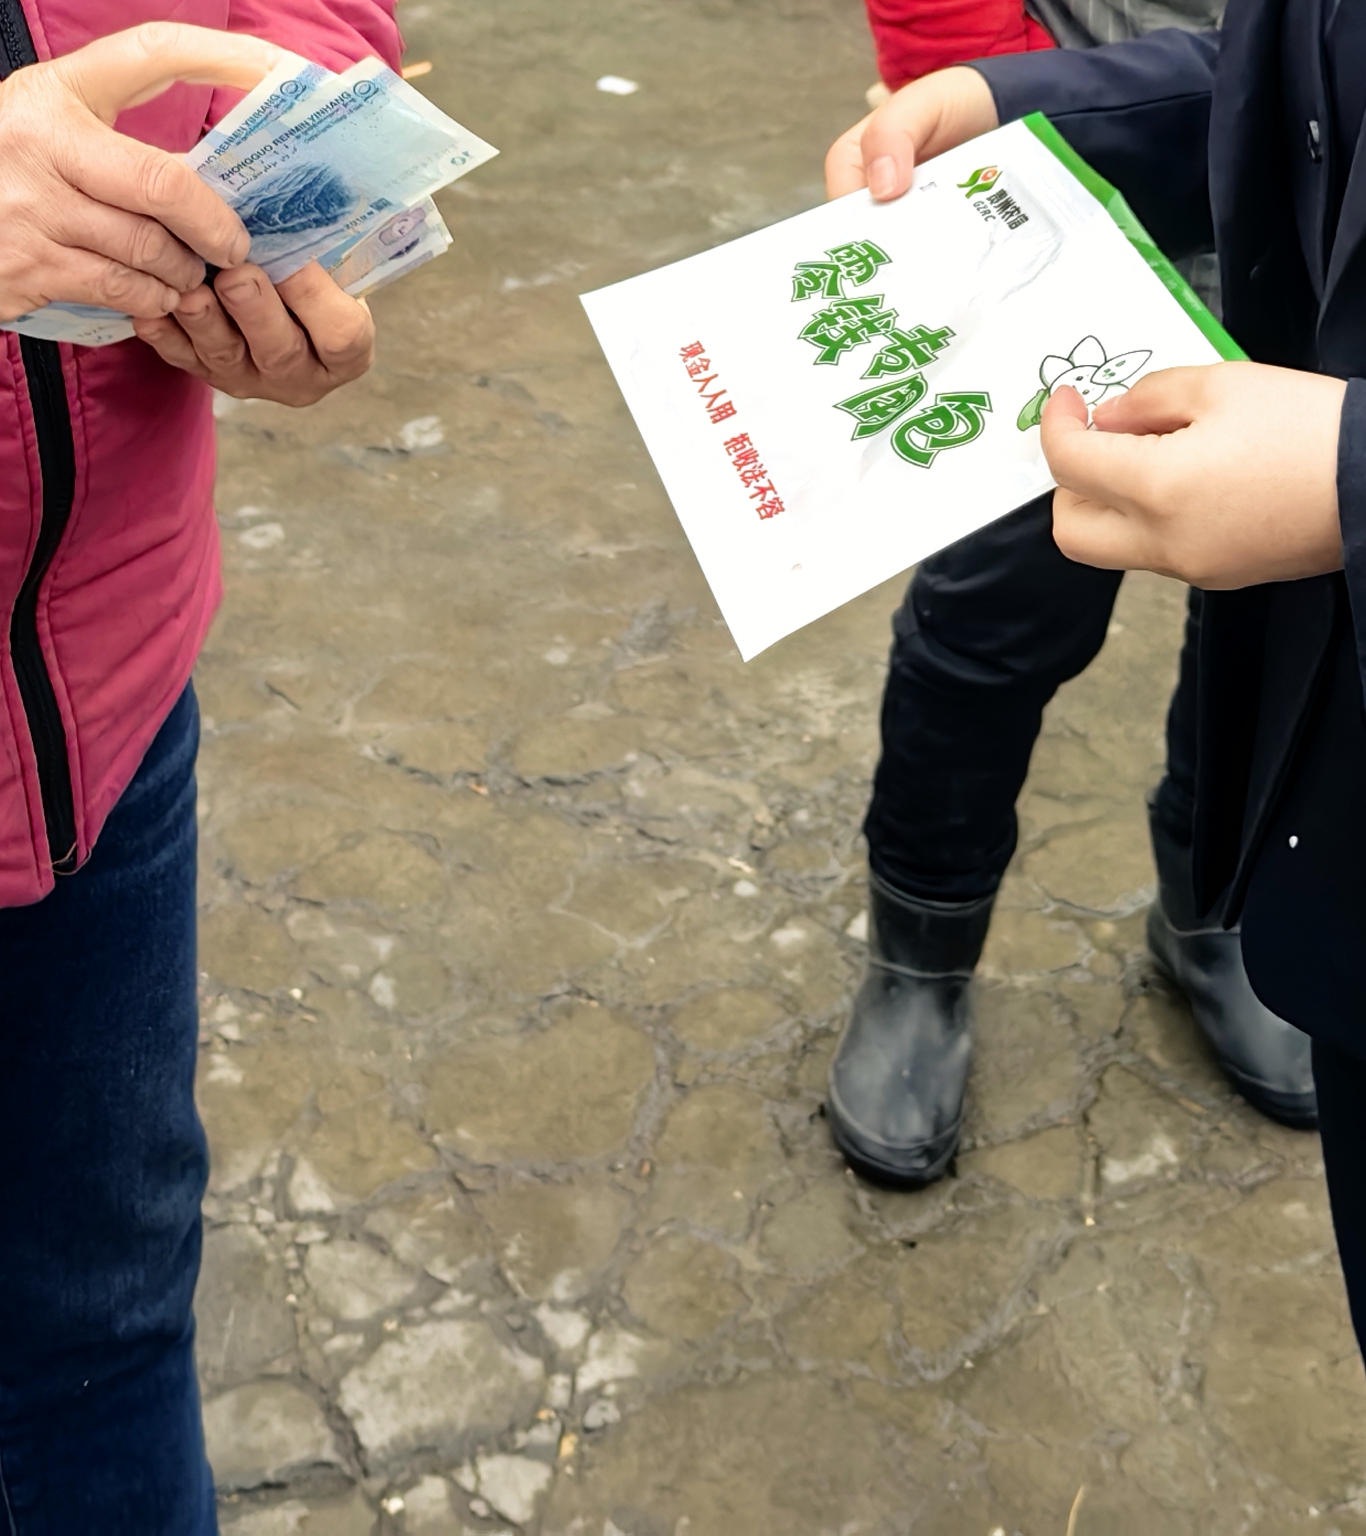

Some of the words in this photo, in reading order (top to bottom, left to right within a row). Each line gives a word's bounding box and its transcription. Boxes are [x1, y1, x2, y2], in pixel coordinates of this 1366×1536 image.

[219, 144, 273, 181] ZHONGGUO
[272, 119, 311, 147] RENMIN
[307, 90, 352, 126] YINHANG
[973, 200, 996, 222] GZRC
[985, 188, 1029, 230] 贵州农信
[790, 238, 993, 469] 零钱专用包
[678, 340, 737, 424] 现金人人用
[723, 432, 785, 520] 拒收法不容
